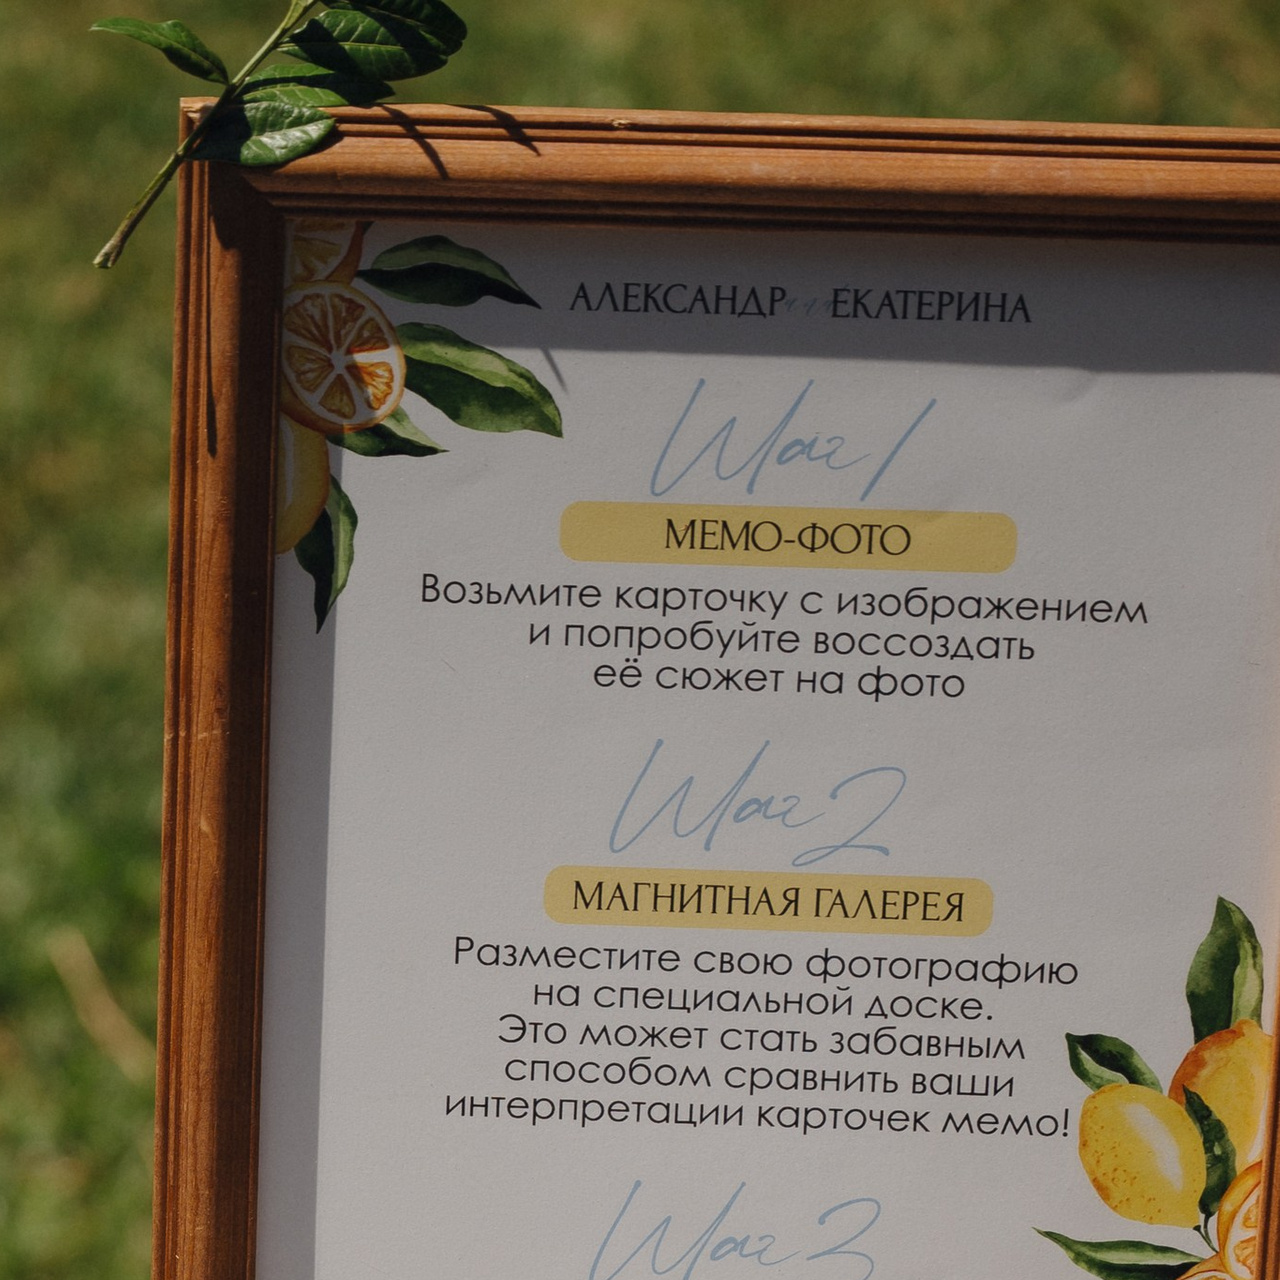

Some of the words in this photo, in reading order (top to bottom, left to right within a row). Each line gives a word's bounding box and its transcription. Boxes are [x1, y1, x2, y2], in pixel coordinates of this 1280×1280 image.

[568, 280, 788, 320] АЛЕКСАНДР
[830, 286, 1033, 325] ЕКАТЕРИНА
[649, 377, 871, 497] Шаг
[664, 517, 913, 557] МЕМО-ФОТО
[420, 572, 603, 609] Возьмите
[614, 585, 790, 622] карточку
[799, 590, 825, 616] с
[836, 585, 1149, 627] изображением
[528, 622, 551, 647] и
[563, 619, 802, 660] попробуйте
[812, 630, 1036, 662] воссоздать
[592, 656, 644, 690] её
[654, 665, 786, 693] сюжет
[795, 669, 845, 696] на
[856, 663, 966, 704] фото
[608, 738, 825, 855] Шаг
[791, 766, 909, 868] 2
[572, 879, 802, 918] МАГНИТНАЯ
[813, 886, 966, 923] ГАЛЕРЕЯ
[453, 935, 682, 973] Разместите
[692, 949, 794, 977] свою
[804, 946, 1080, 991] фотографию
[532, 982, 581, 1008] на
[592, 984, 854, 1017] специальной
[863, 994, 994, 1022] доске.
[497, 1012, 568, 1046] Это
[577, 1022, 710, 1050] может
[719, 1027, 819, 1054] стать
[828, 1024, 1027, 1061] забавным
[503, 1055, 713, 1089] способом
[723, 1065, 900, 1097] сравнить
[910, 1071, 1015, 1099] ваши
[444, 1093, 745, 1129] интерпретации
[756, 1104, 932, 1137] карточек
[940, 1107, 1070, 1139] мемо!
